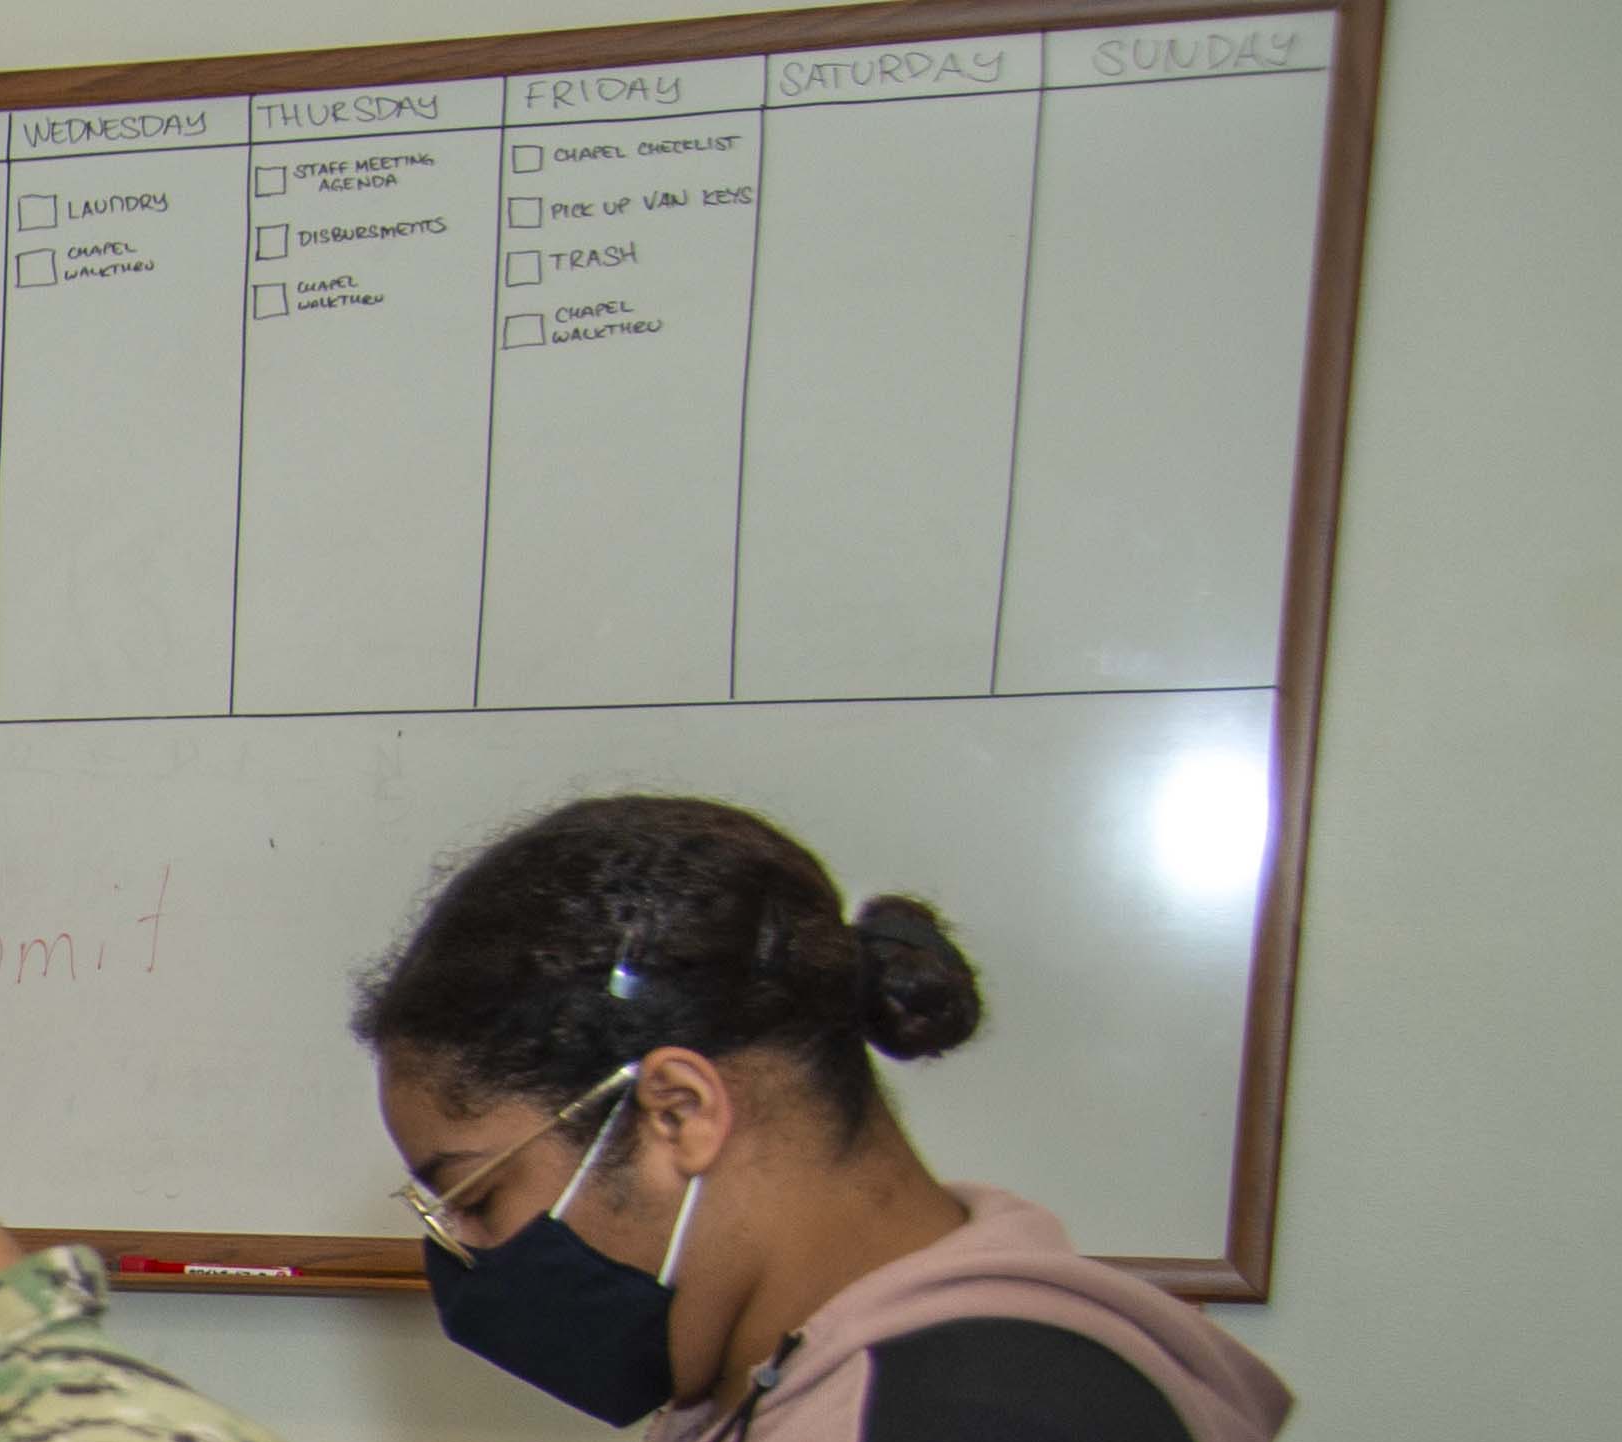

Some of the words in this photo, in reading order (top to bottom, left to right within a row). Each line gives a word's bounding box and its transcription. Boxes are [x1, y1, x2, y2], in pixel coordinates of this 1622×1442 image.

[1092, 31, 1299, 76] SUNDAY
[779, 50, 1003, 97] SATURDAY
[525, 77, 680, 109] FRIDAY
[257, 94, 438, 128] THURSDAY
[24, 111, 207, 148] WEDNESDAY
[554, 146, 626, 162] CHAPEL
[638, 136, 741, 155] CHECKLIST
[294, 161, 350, 179] STAFF
[355, 153, 434, 173] MEETING
[318, 174, 397, 192] AGENDA
[68, 193, 168, 221] LAUNDRY
[551, 203, 593, 220] PICK
[603, 198, 631, 216] UP
[643, 189, 686, 210] VAN
[702, 186, 753, 206] KEYS
[68, 241, 136, 260] CHAPEL
[549, 243, 638, 271] TRASH
[64, 260, 155, 281] WALKTHRU
[298, 276, 358, 292] CHAPEL
[555, 301, 634, 323] CHAPEL
[552, 320, 663, 344] WALKTHRU
